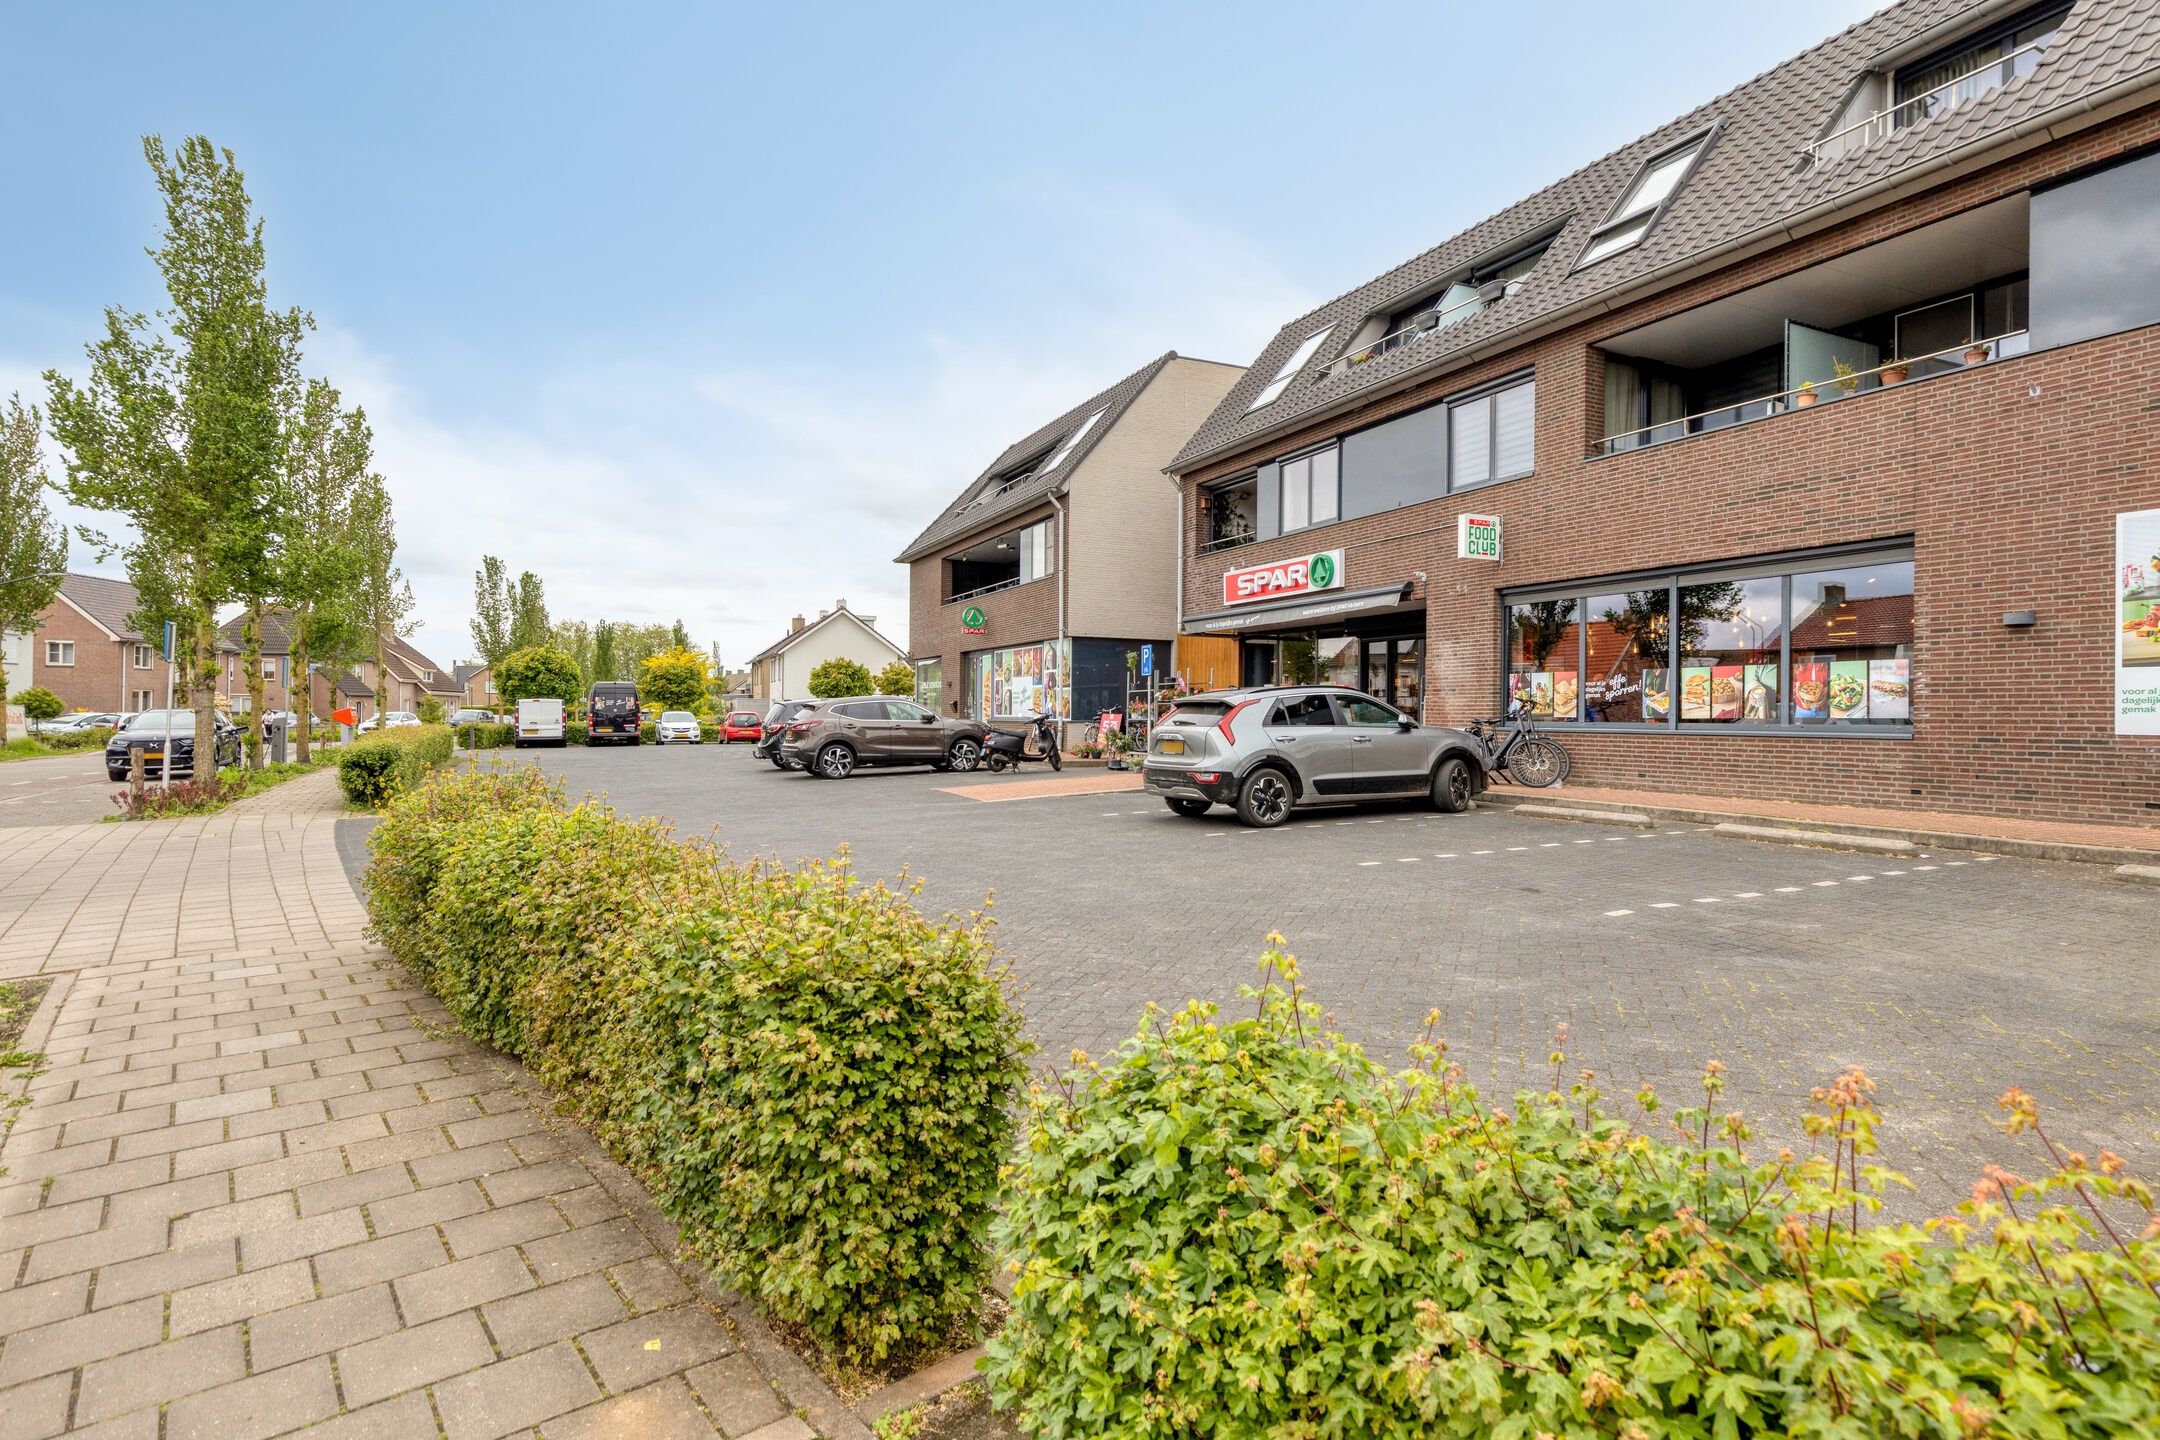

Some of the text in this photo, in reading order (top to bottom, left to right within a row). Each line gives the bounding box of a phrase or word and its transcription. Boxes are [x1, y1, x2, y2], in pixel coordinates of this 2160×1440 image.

[1469, 526, 1496, 541] FOOD
[1469, 541, 1496, 556] CLUB
[1237, 564, 1308, 596] SPAR
[1143, 648, 1149, 663] P
[1609, 673, 1627, 690] effe
[2121, 706, 2156, 714] gemak
